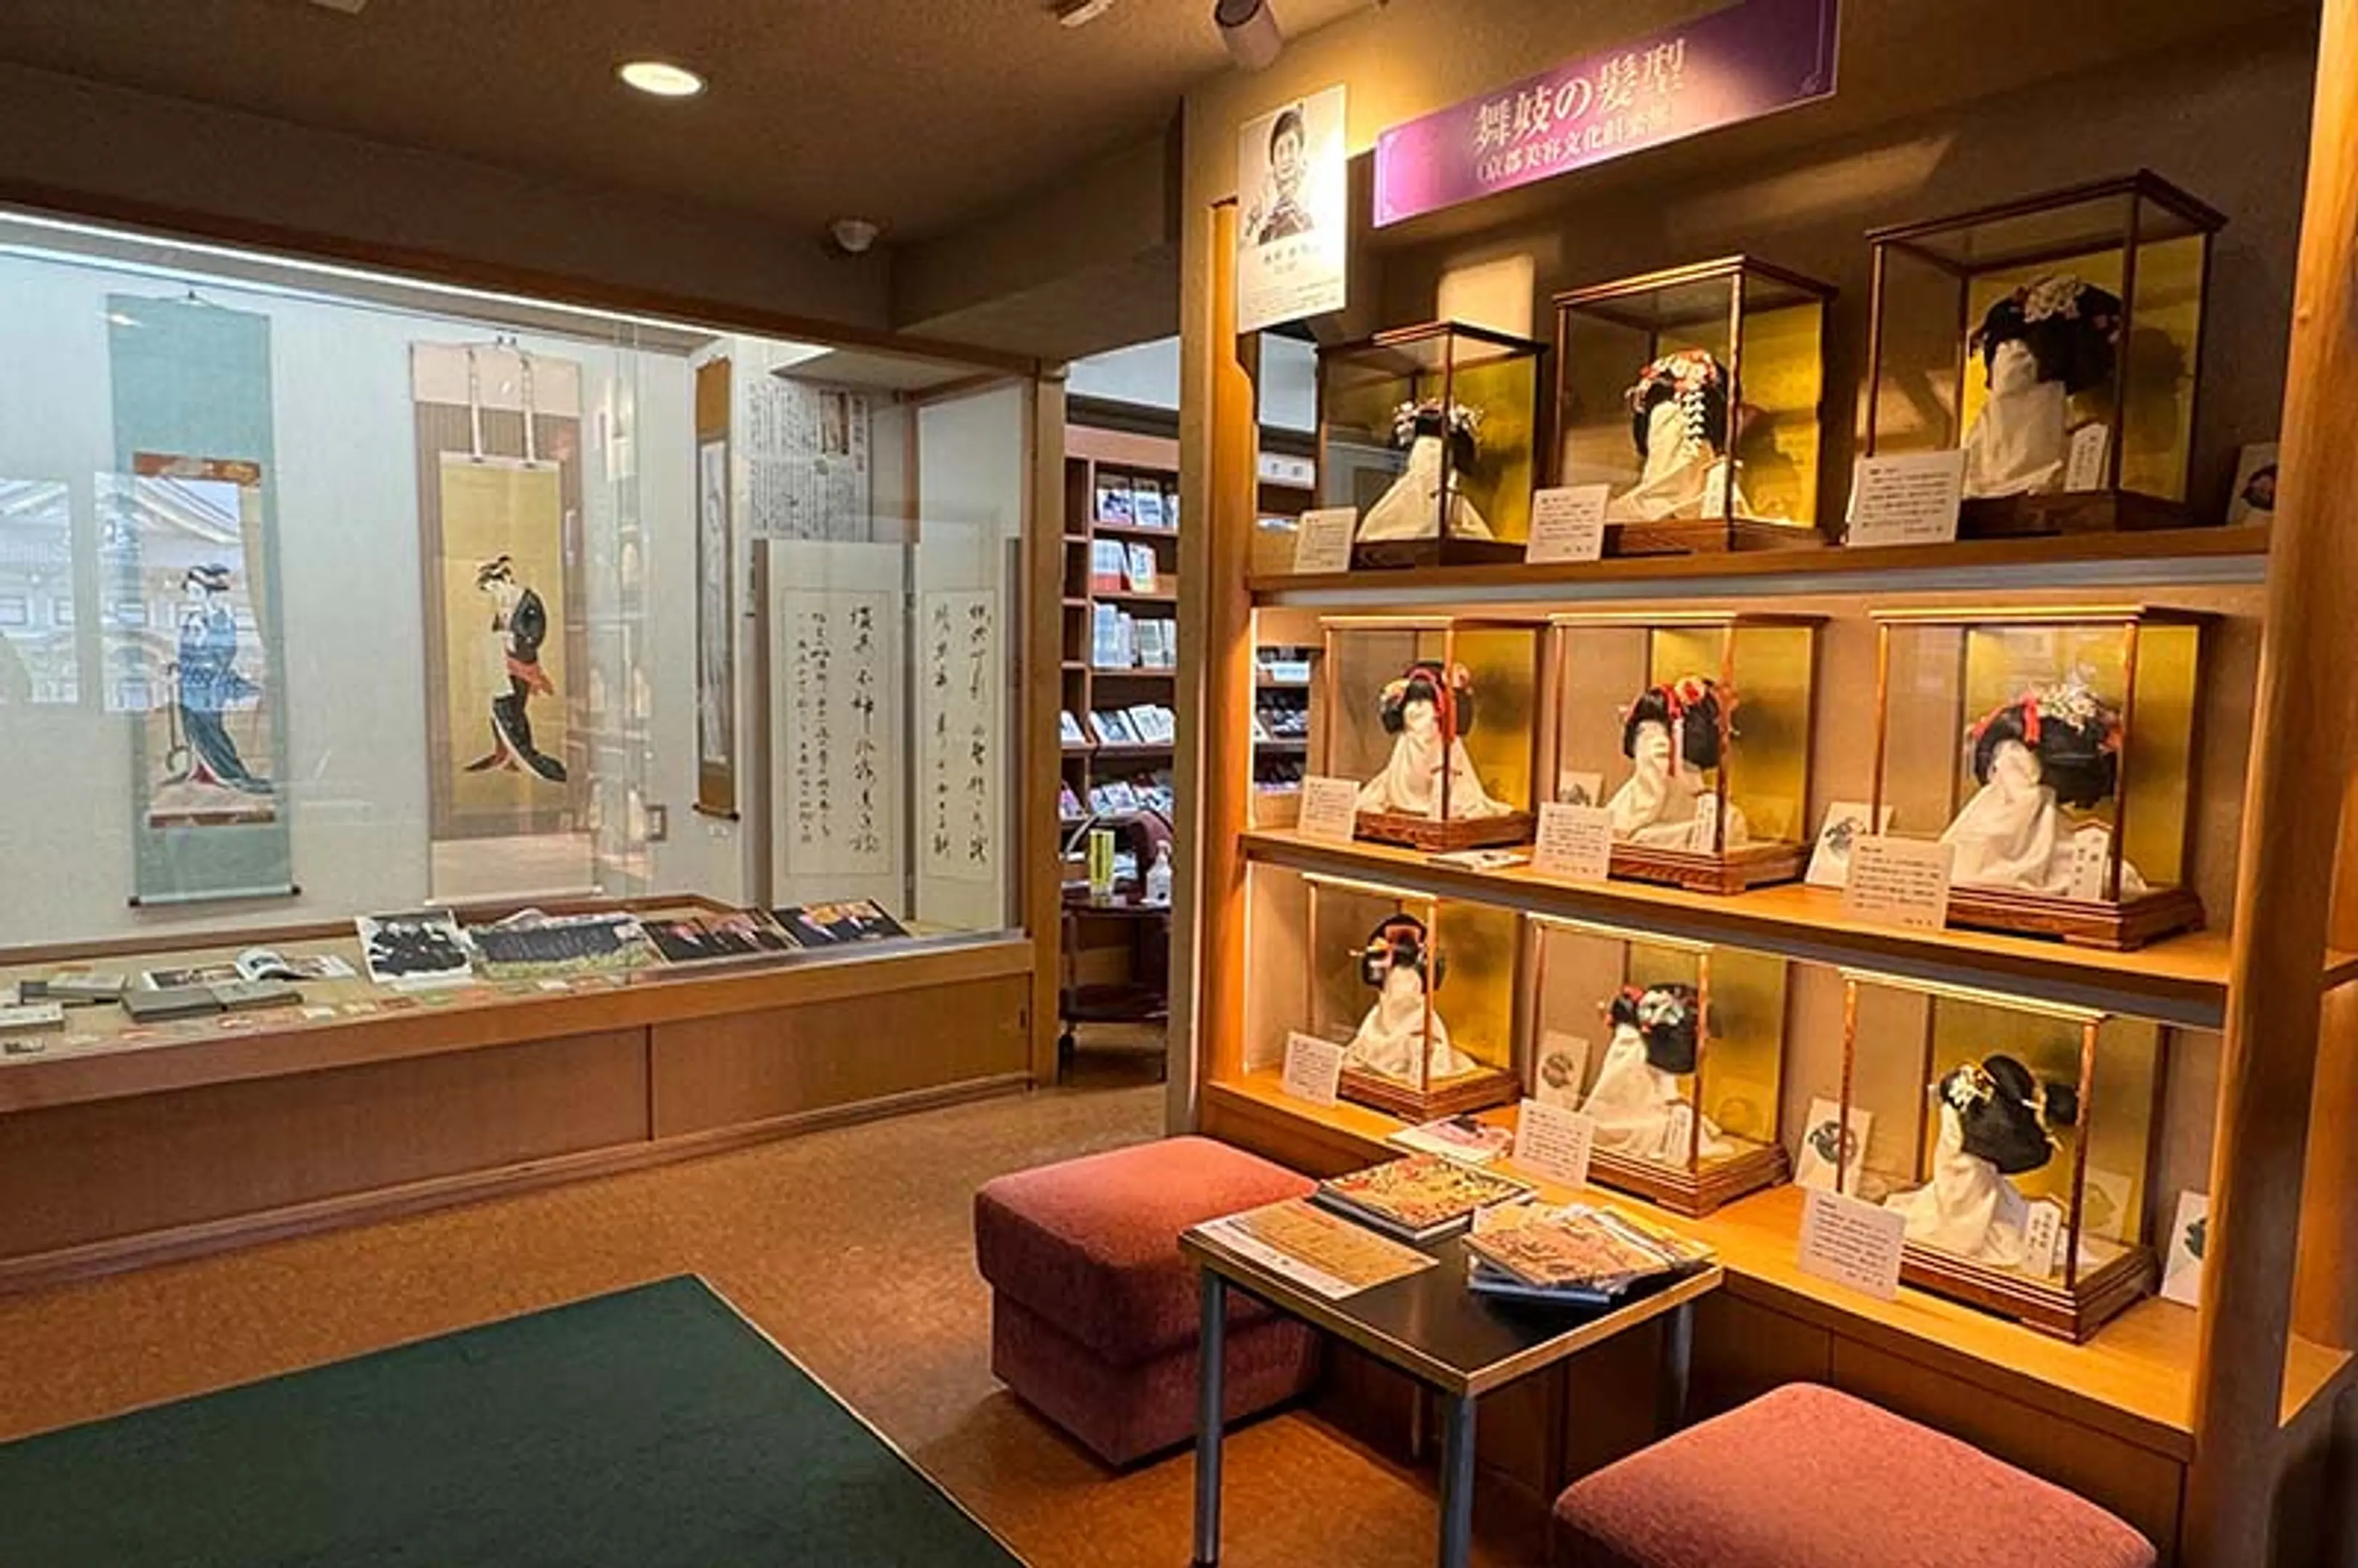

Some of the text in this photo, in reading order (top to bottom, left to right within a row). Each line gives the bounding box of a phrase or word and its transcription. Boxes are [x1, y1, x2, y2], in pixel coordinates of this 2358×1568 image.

[1474, 38, 1685, 152] 舞妓の髪型
